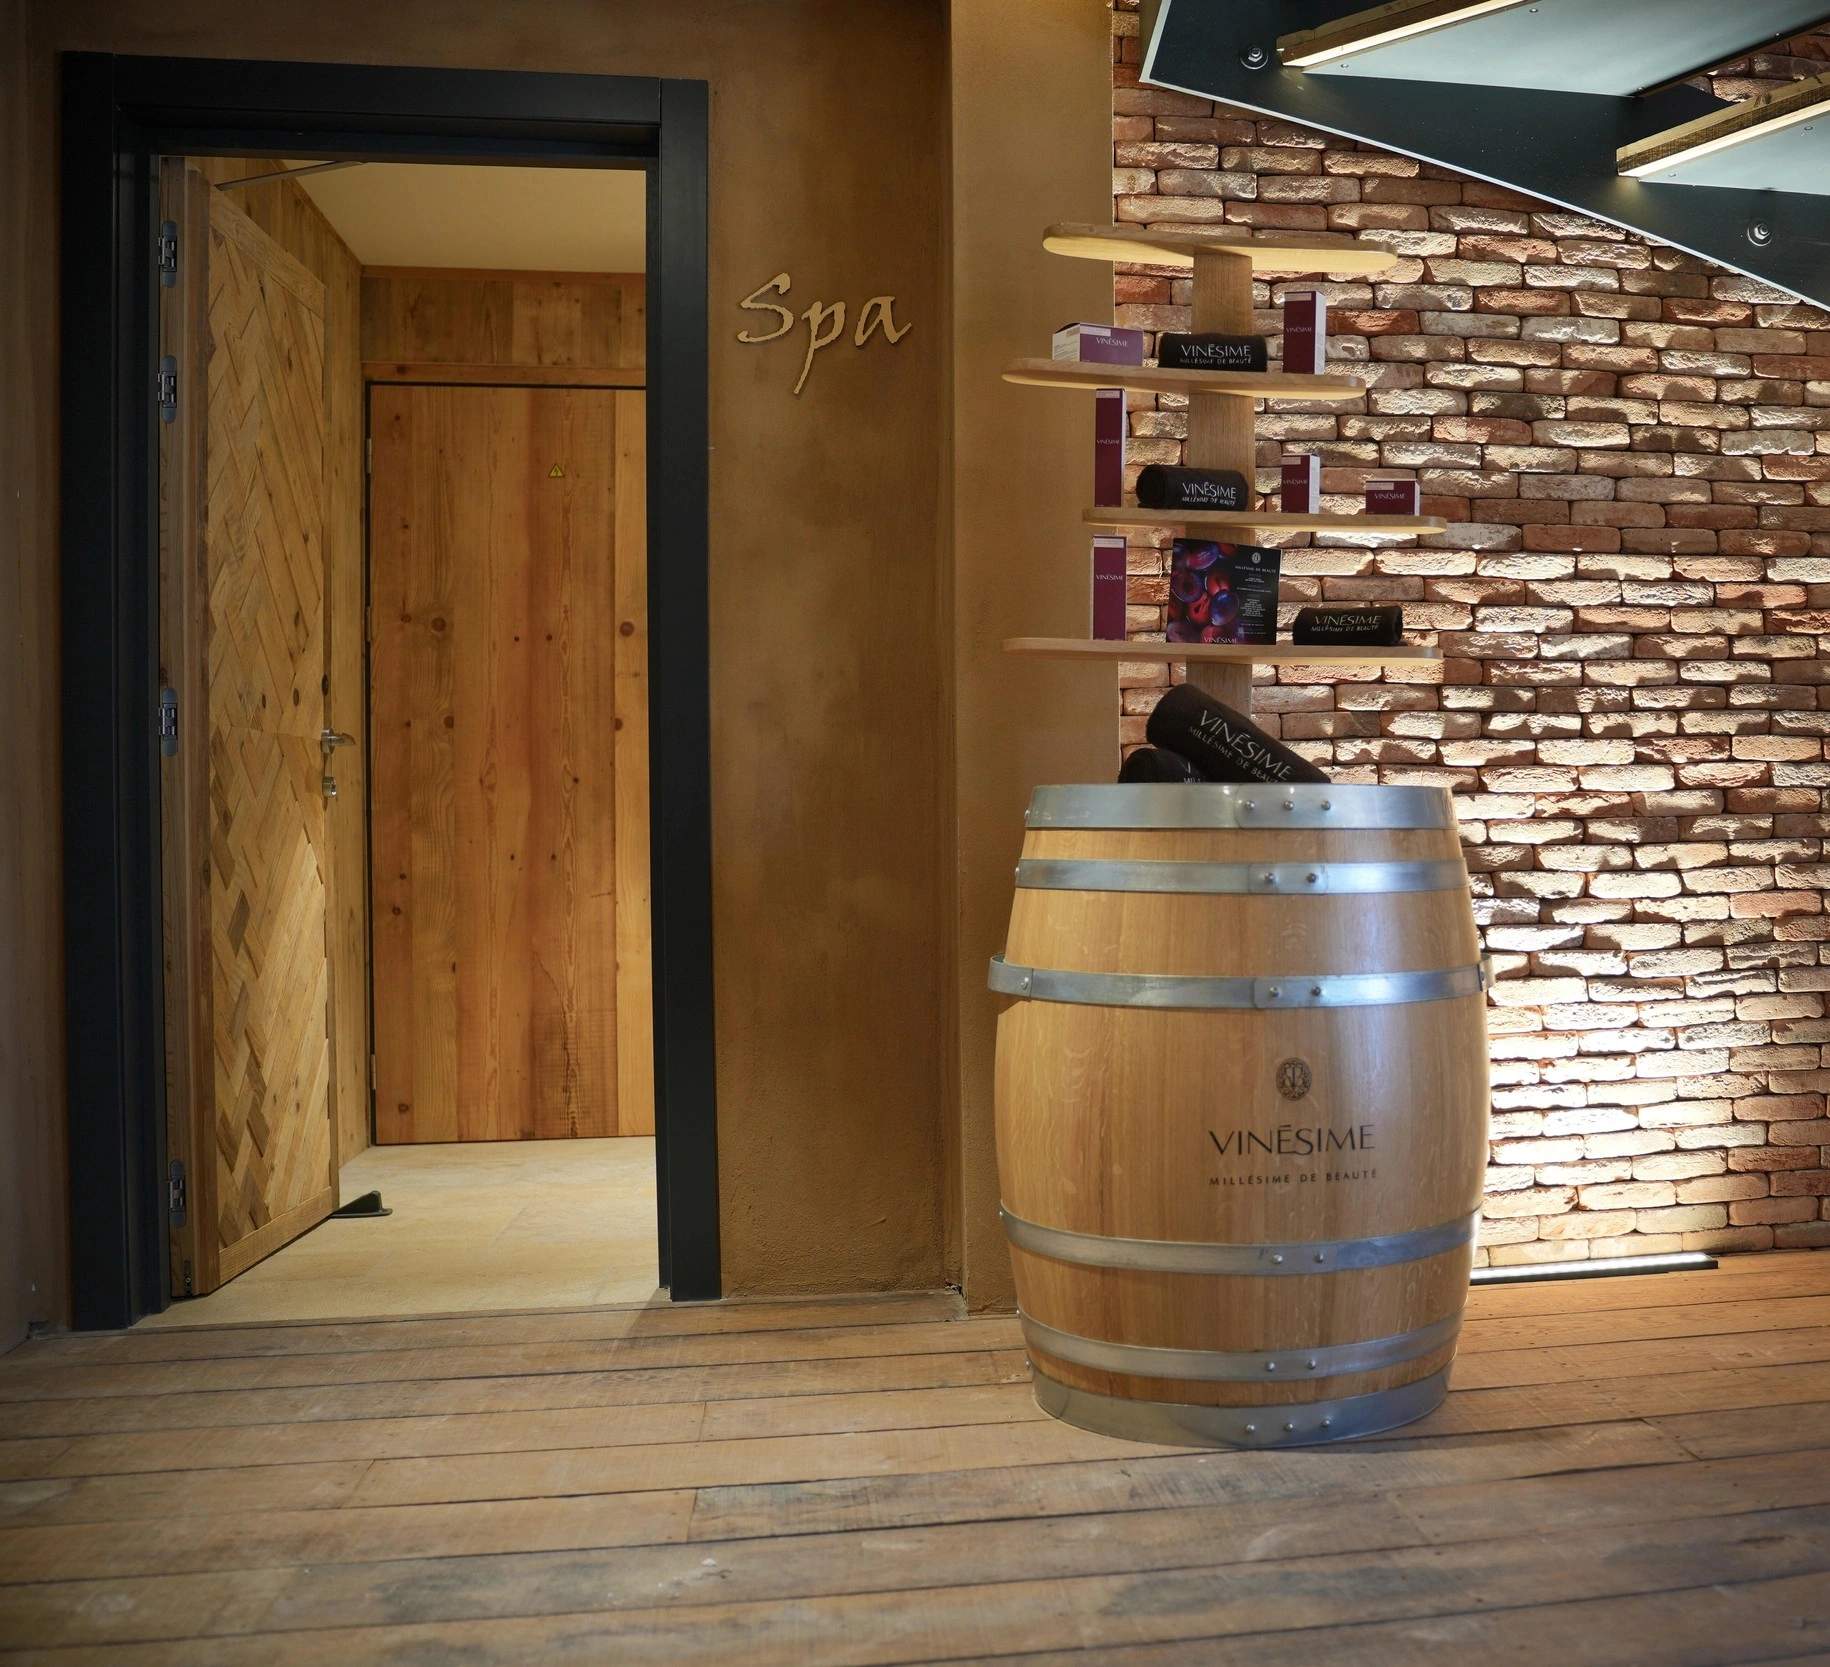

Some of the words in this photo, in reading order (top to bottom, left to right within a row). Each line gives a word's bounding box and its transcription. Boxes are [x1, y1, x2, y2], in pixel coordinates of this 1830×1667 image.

[737, 272, 912, 394] Spa
[1299, 1172, 1318, 1184] DE
[1325, 1167, 1377, 1183] BEAUTÉ
